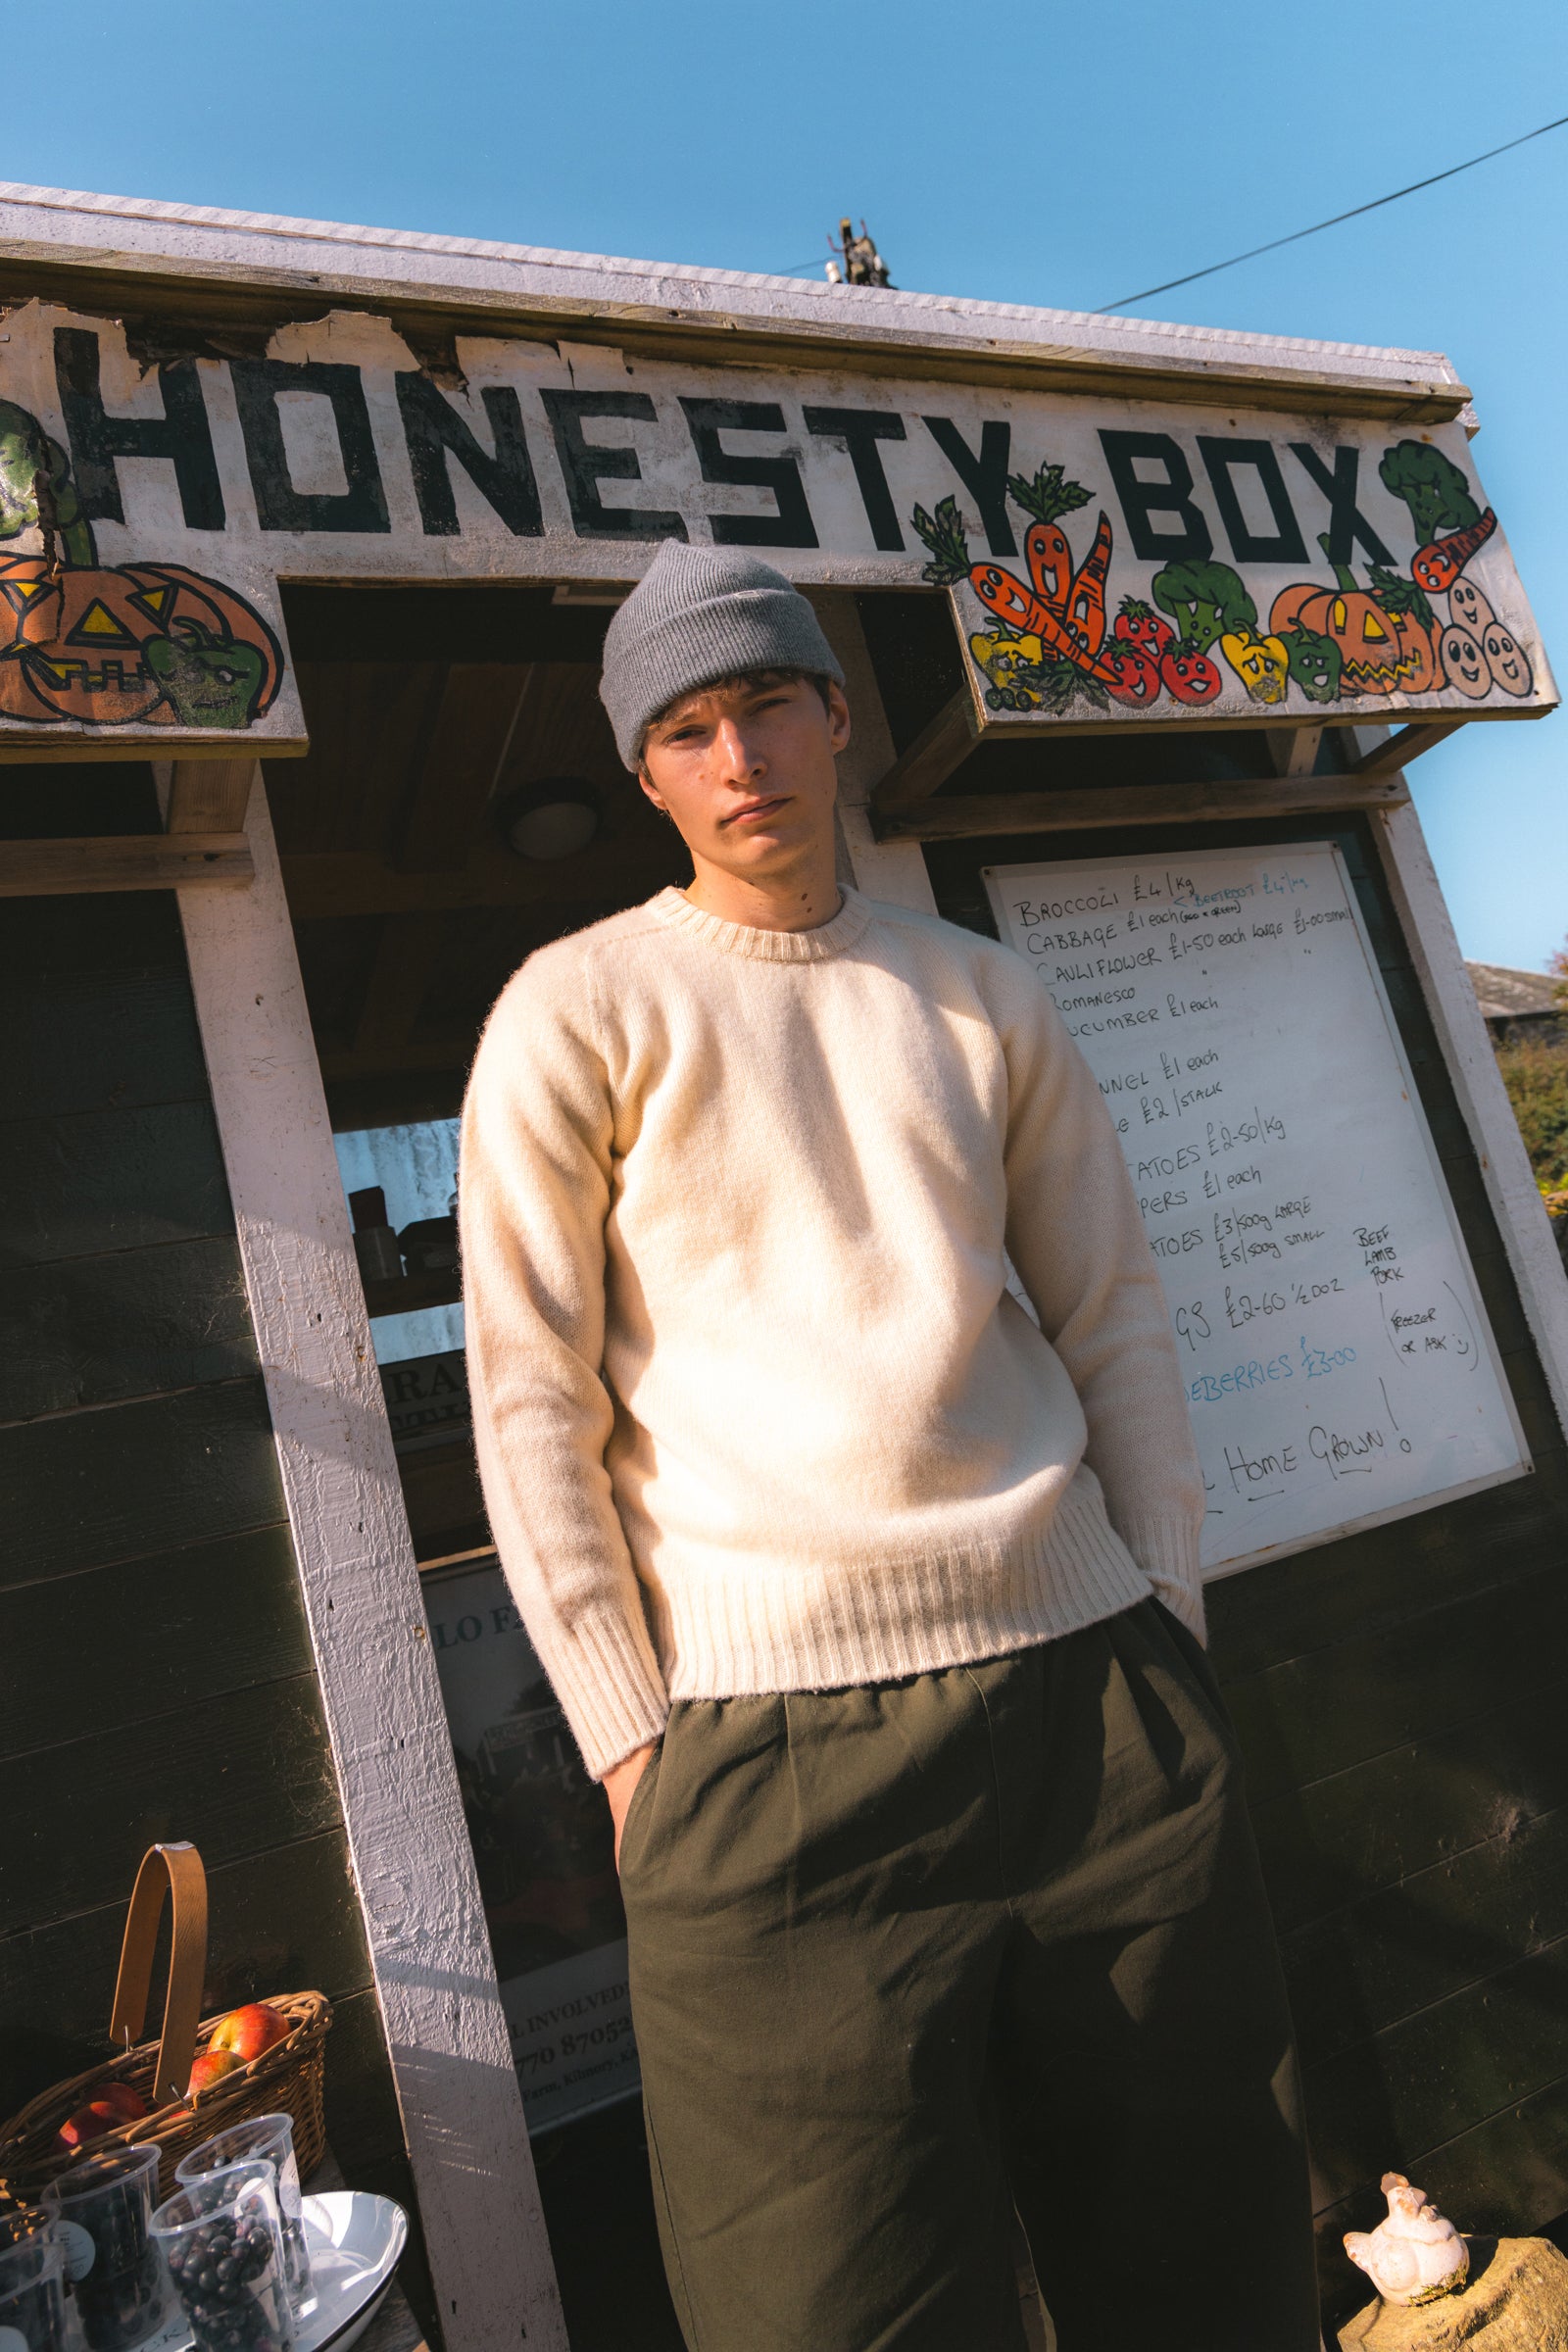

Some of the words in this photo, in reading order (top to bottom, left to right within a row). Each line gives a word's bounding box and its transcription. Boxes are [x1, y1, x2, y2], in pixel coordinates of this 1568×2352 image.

[52, 327, 1018, 556] HONESTY
[1097, 427, 1399, 566] BOX
[1012, 893, 1119, 927] BROCCOLI
[1027, 923, 1118, 955] CABBAGE
[1128, 910, 1145, 932] £1
[1149, 908, 1179, 927] each
[1036, 947, 1162, 986] CAULIFLOWER
[1218, 927, 1248, 946] each
[1166, 994, 1187, 1017] £1
[1190, 997, 1219, 1012] each
[1160, 1052, 1180, 1080] £1
[1187, 1049, 1219, 1071] each
[1126, 1145, 1201, 1180] ATOES
[1137, 1191, 1188, 1218] PERS
[1202, 1170, 1221, 1199] £1
[1227, 1166, 1262, 1190] each
[1352, 1224, 1390, 1248] BEEF
[1364, 1247, 1397, 1266] LAMB
